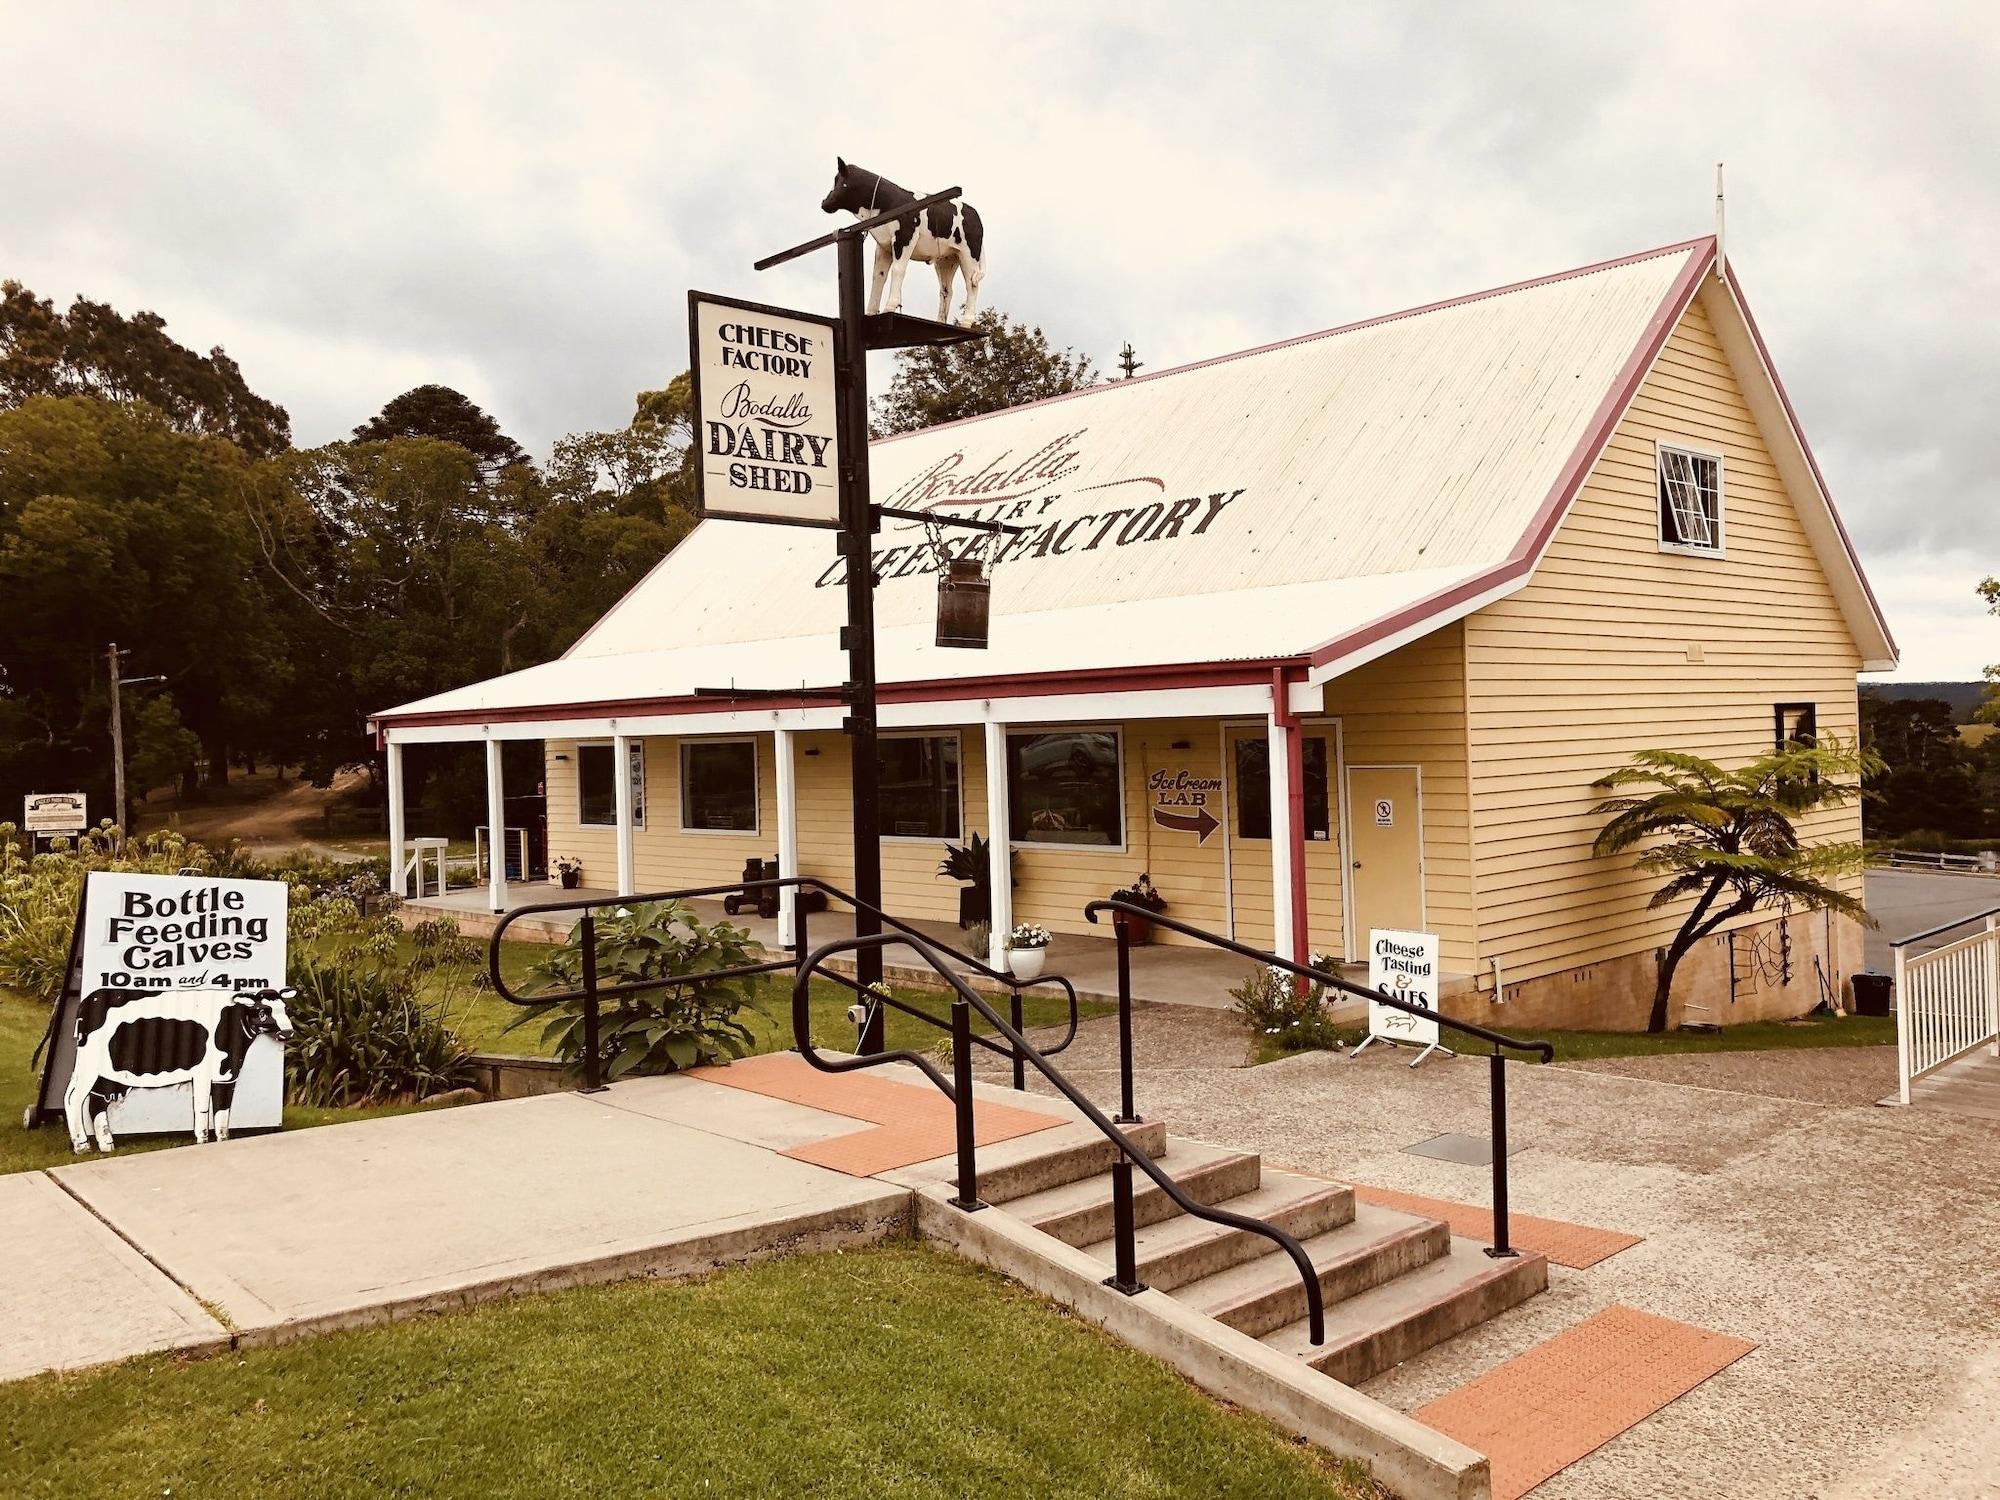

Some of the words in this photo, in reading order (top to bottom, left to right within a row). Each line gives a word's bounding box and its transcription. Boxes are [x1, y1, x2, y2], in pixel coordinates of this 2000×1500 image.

[719, 323, 813, 357] CHEESE
[722, 346, 812, 379] FACTORY
[720, 379, 813, 424] Bodalla
[706, 420, 833, 468] DAIRY
[729, 462, 812, 494] SHED
[990, 488, 1247, 564] FACTORY
[1149, 769, 1175, 790] Ice
[1175, 769, 1222, 791] Cream
[1158, 792, 1206, 806] LAB
[123, 886, 244, 918] Bottle
[108, 913, 268, 945] Feeding
[123, 940, 252, 970] Calves
[1376, 939, 1424, 958] Cheese
[179, 969, 209, 988] and
[211, 973, 269, 991] 4pm
[1382, 956, 1431, 976] Tasting
[1396, 974, 1413, 989] &
